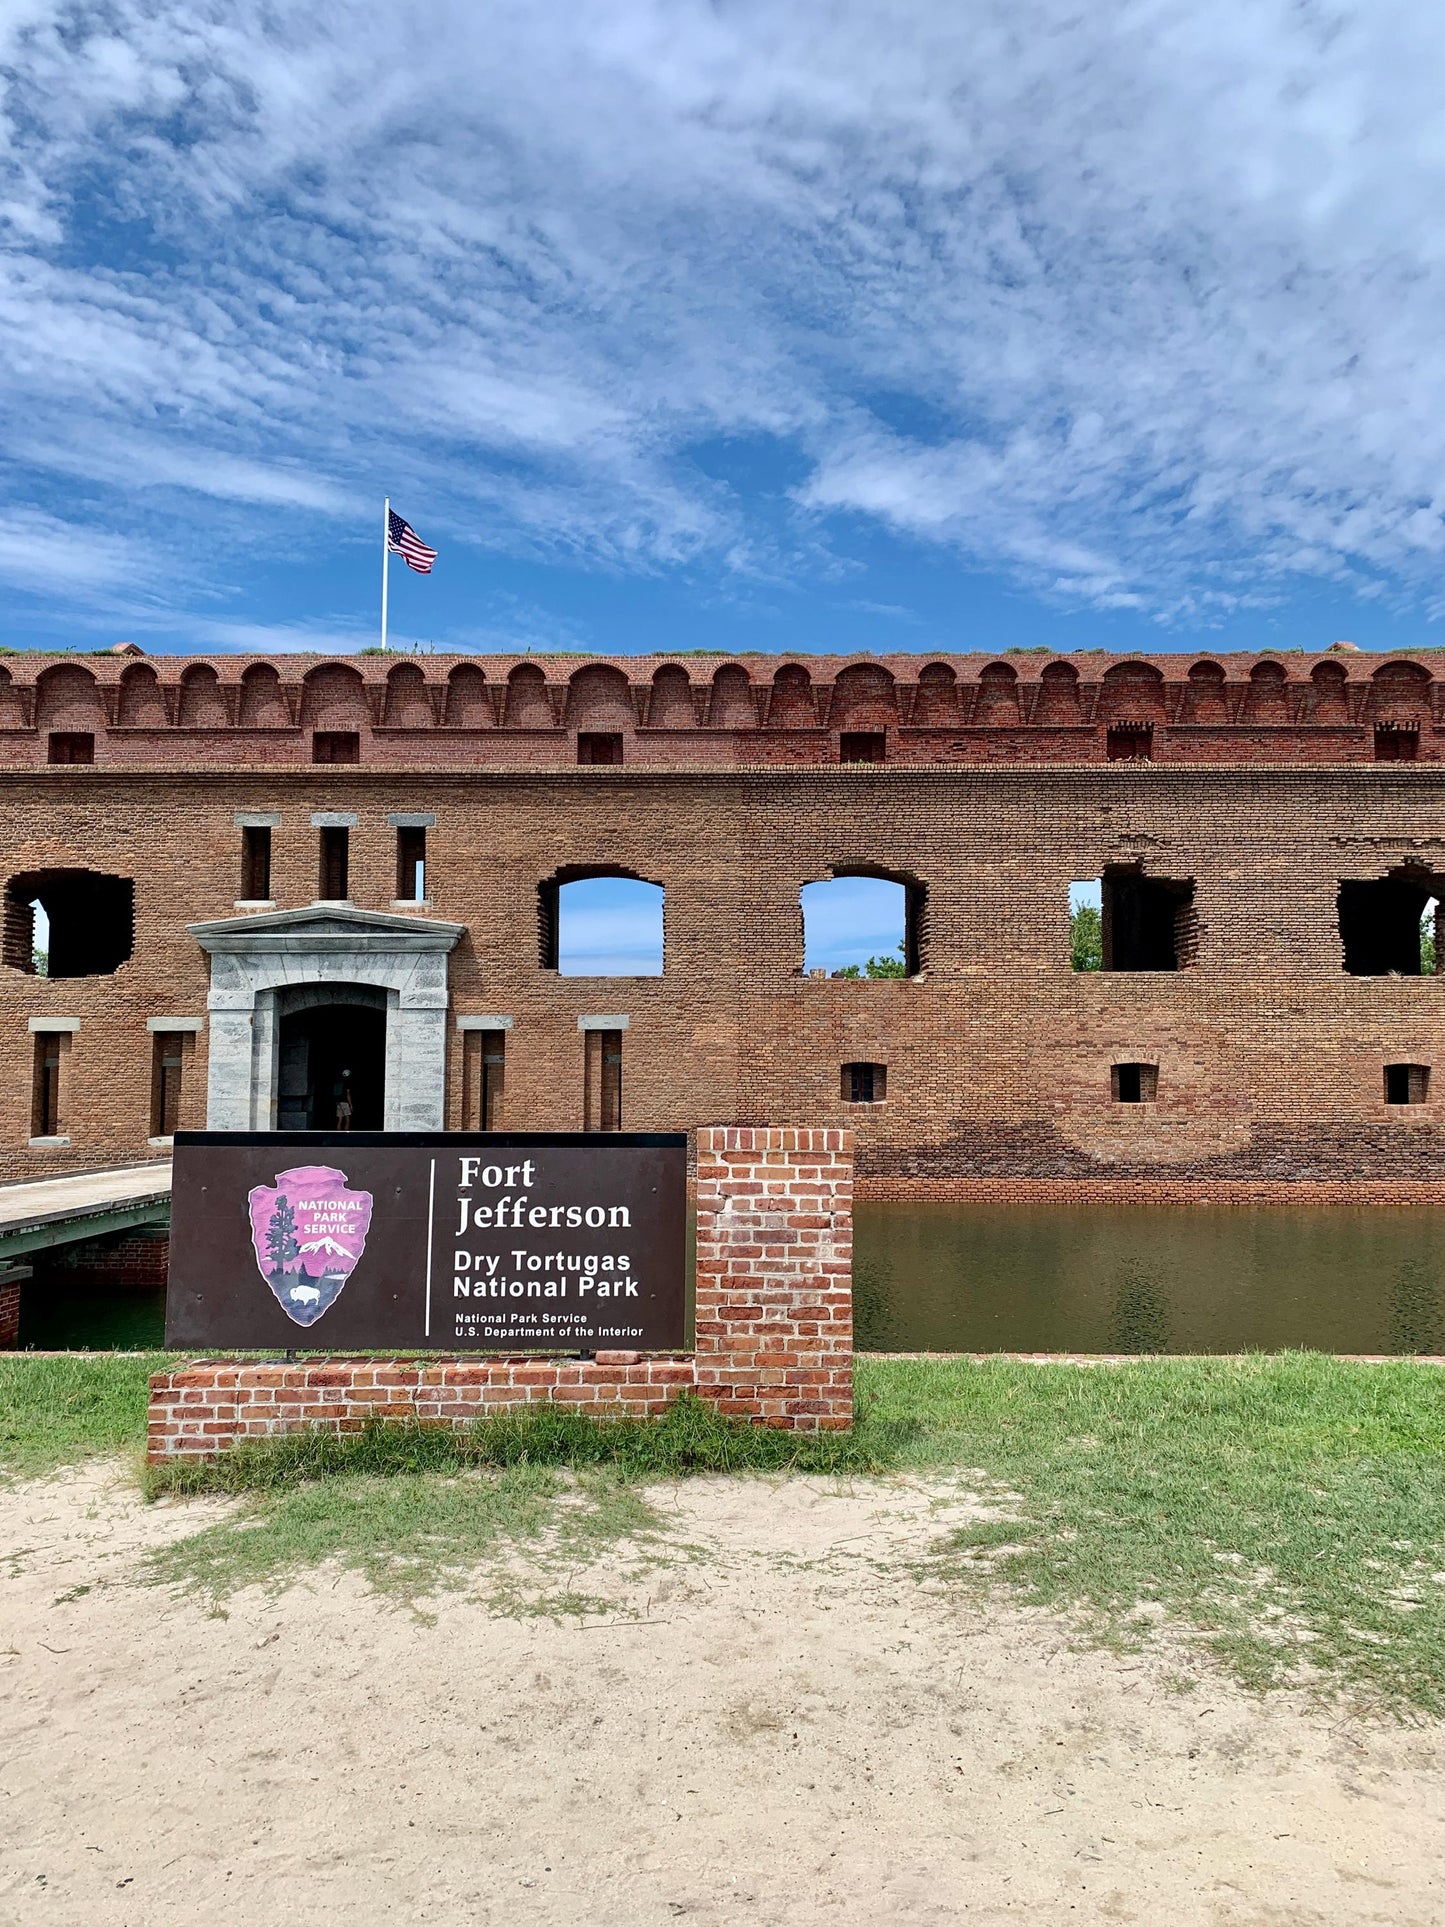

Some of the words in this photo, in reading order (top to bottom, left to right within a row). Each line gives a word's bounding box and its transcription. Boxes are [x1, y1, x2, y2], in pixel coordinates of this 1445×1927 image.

[458, 1156, 536, 1188] Fort
[298, 1200, 363, 1211] NATIONAL
[313, 1212, 348, 1222] PARK
[455, 1196, 632, 1237] Jefferson
[303, 1224, 356, 1234] SERVICE
[454, 1250, 501, 1277] Dry
[510, 1250, 631, 1276] Tortugas
[453, 1276, 567, 1298] National
[578, 1276, 639, 1297] Park
[455, 1313, 506, 1323] National
[511, 1313, 538, 1323] Park
[542, 1313, 588, 1323] Service
[455, 1326, 480, 1337] U.S.
[484, 1326, 555, 1339] Department
[558, 1326, 571, 1337] of
[574, 1326, 594, 1337] the
[598, 1326, 644, 1337] Interior
